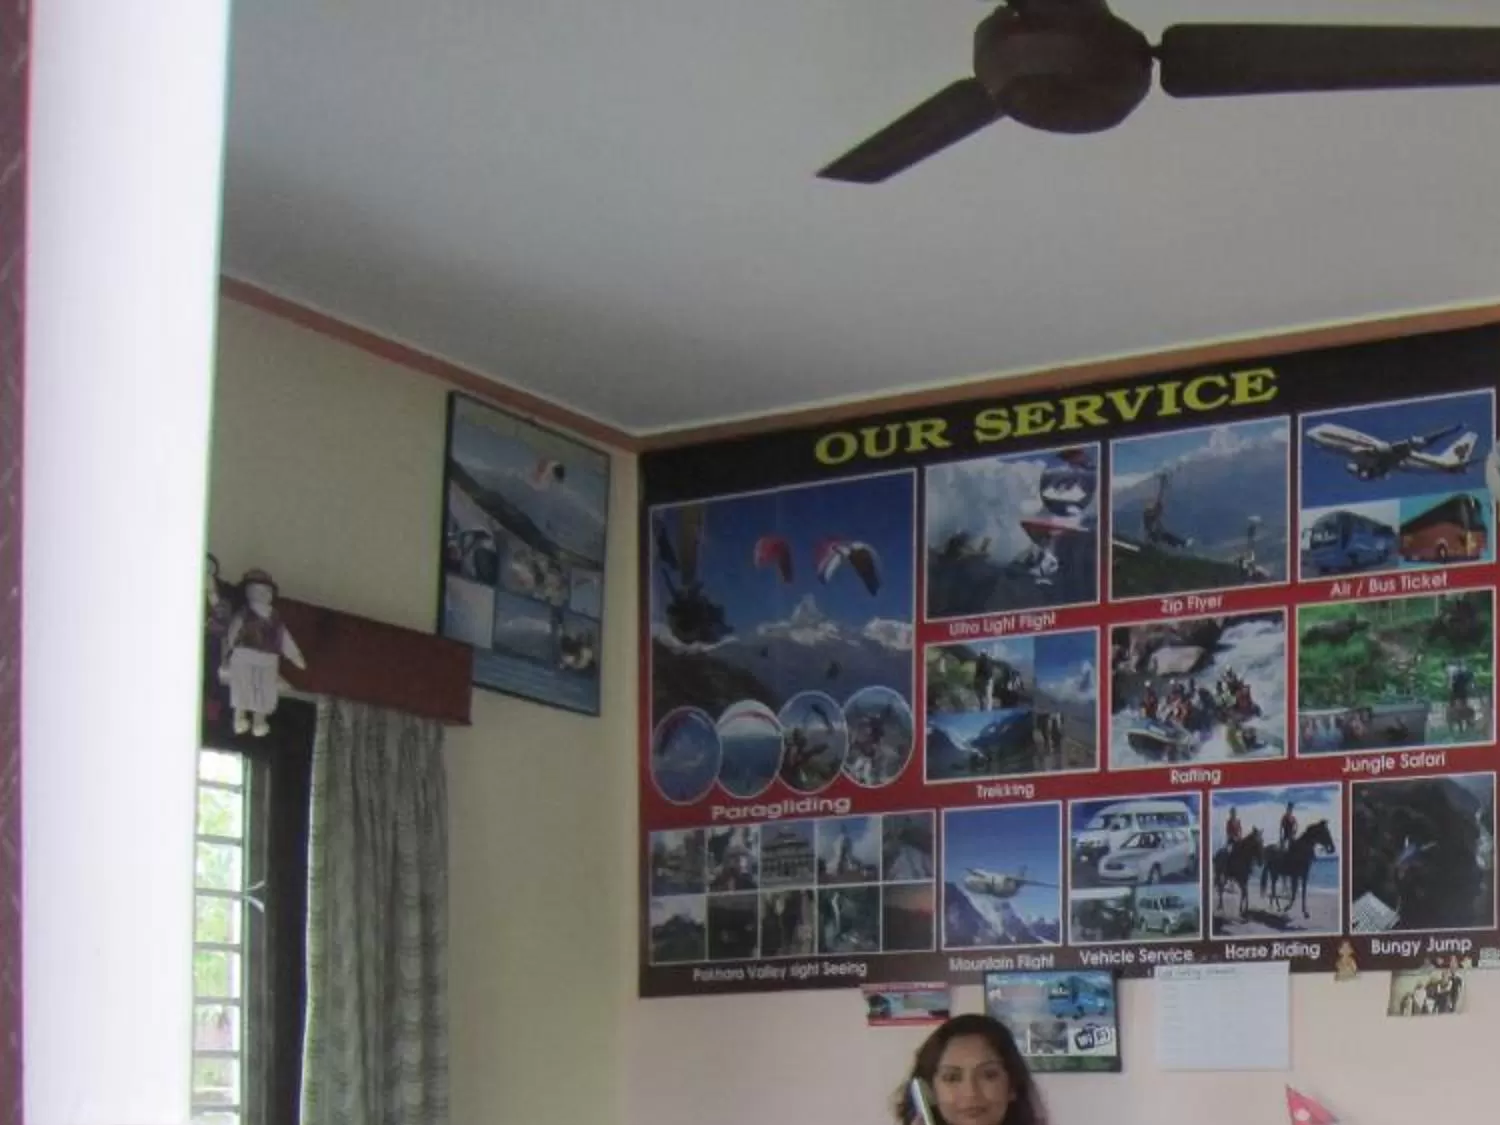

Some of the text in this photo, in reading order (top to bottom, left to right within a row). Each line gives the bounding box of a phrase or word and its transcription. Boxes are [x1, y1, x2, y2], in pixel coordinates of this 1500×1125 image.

[815, 368, 1279, 466] OUR SERVICE
[1330, 580, 1353, 597] Air
[1369, 577, 1396, 595] Bus
[1399, 572, 1448, 592] Ticket
[1160, 594, 1223, 615] Zip Flyer
[1019, 612, 1057, 632] Flight
[1342, 751, 1446, 774] Jungle Safari
[1170, 768, 1222, 785] Rafting
[976, 784, 1035, 800] Trekking
[711, 795, 852, 821] Paragliding
[1079, 946, 1194, 965] Vehicle Service
[1225, 940, 1321, 960] Horse Riding
[1371, 936, 1473, 957] Bungy Jump
[823, 960, 868, 979] Seeing
[949, 953, 1055, 973] Mountain Flight
